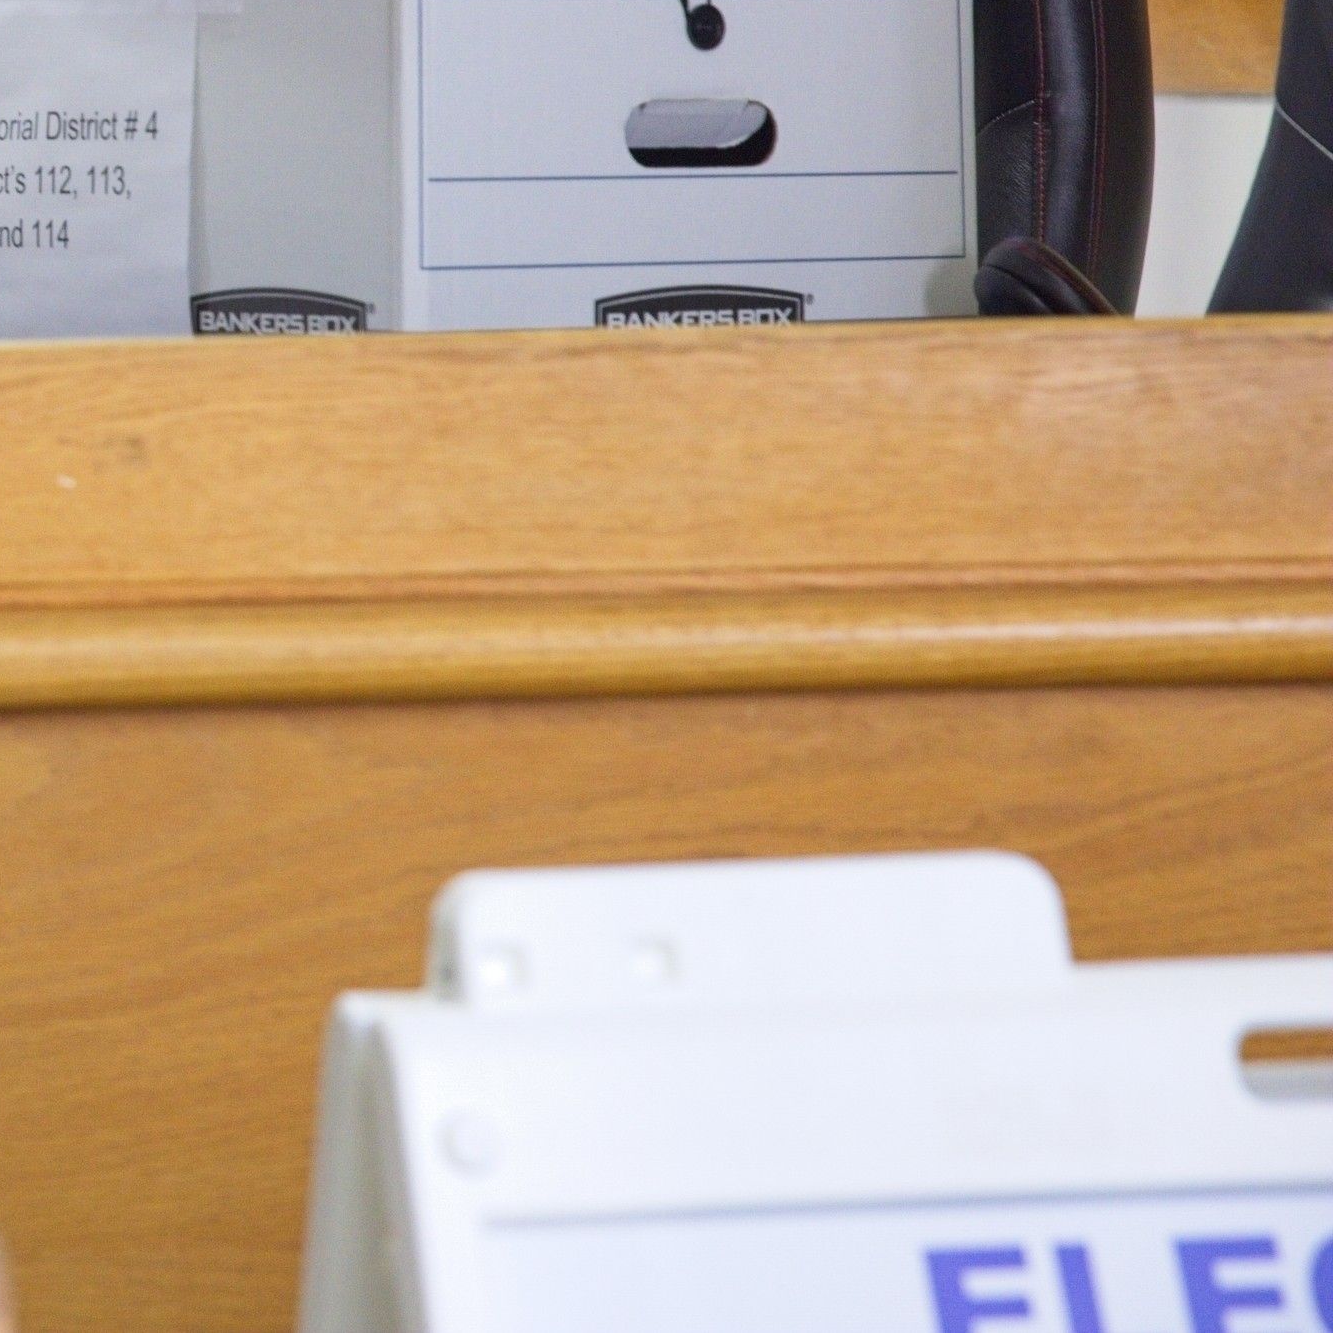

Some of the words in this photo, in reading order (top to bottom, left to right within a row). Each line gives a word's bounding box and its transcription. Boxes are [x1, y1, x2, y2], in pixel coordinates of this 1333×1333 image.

[45, 110, 118, 141] District
[123, 112, 139, 139] #
[144, 111, 159, 140] 4
[34, 164, 78, 199] 112,
[87, 164, 132, 200] 113,
[32, 219, 70, 249] 114
[199, 310, 305, 335] BANKERS
[306, 314, 356, 335] BOX
[606, 310, 734, 329] BANKERS
[735, 307, 793, 326] BOX
[924, 1234, 1333, 1333] ELE
